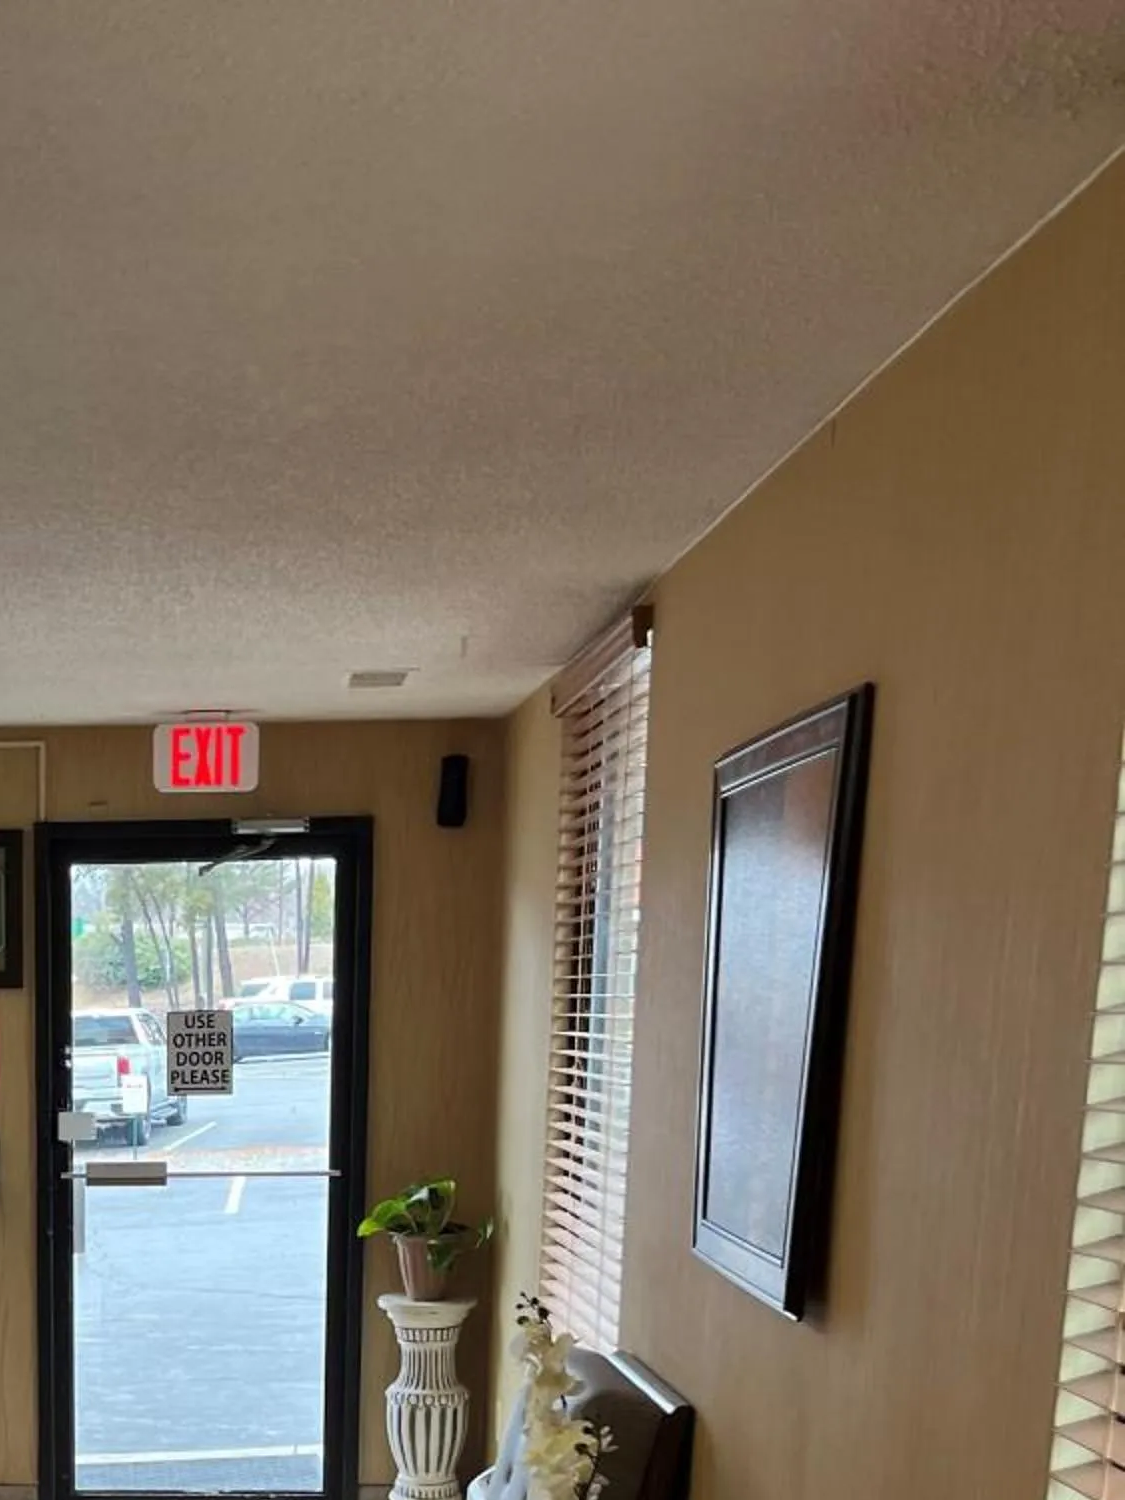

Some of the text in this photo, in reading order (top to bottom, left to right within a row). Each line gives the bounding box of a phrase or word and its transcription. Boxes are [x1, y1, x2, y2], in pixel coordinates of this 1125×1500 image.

[171, 726, 246, 787] EXIT
[184, 1013, 216, 1029] USE
[173, 1031, 227, 1049] OTHER
[176, 1051, 224, 1067] DOOR
[171, 1069, 230, 1085] PLEASE
